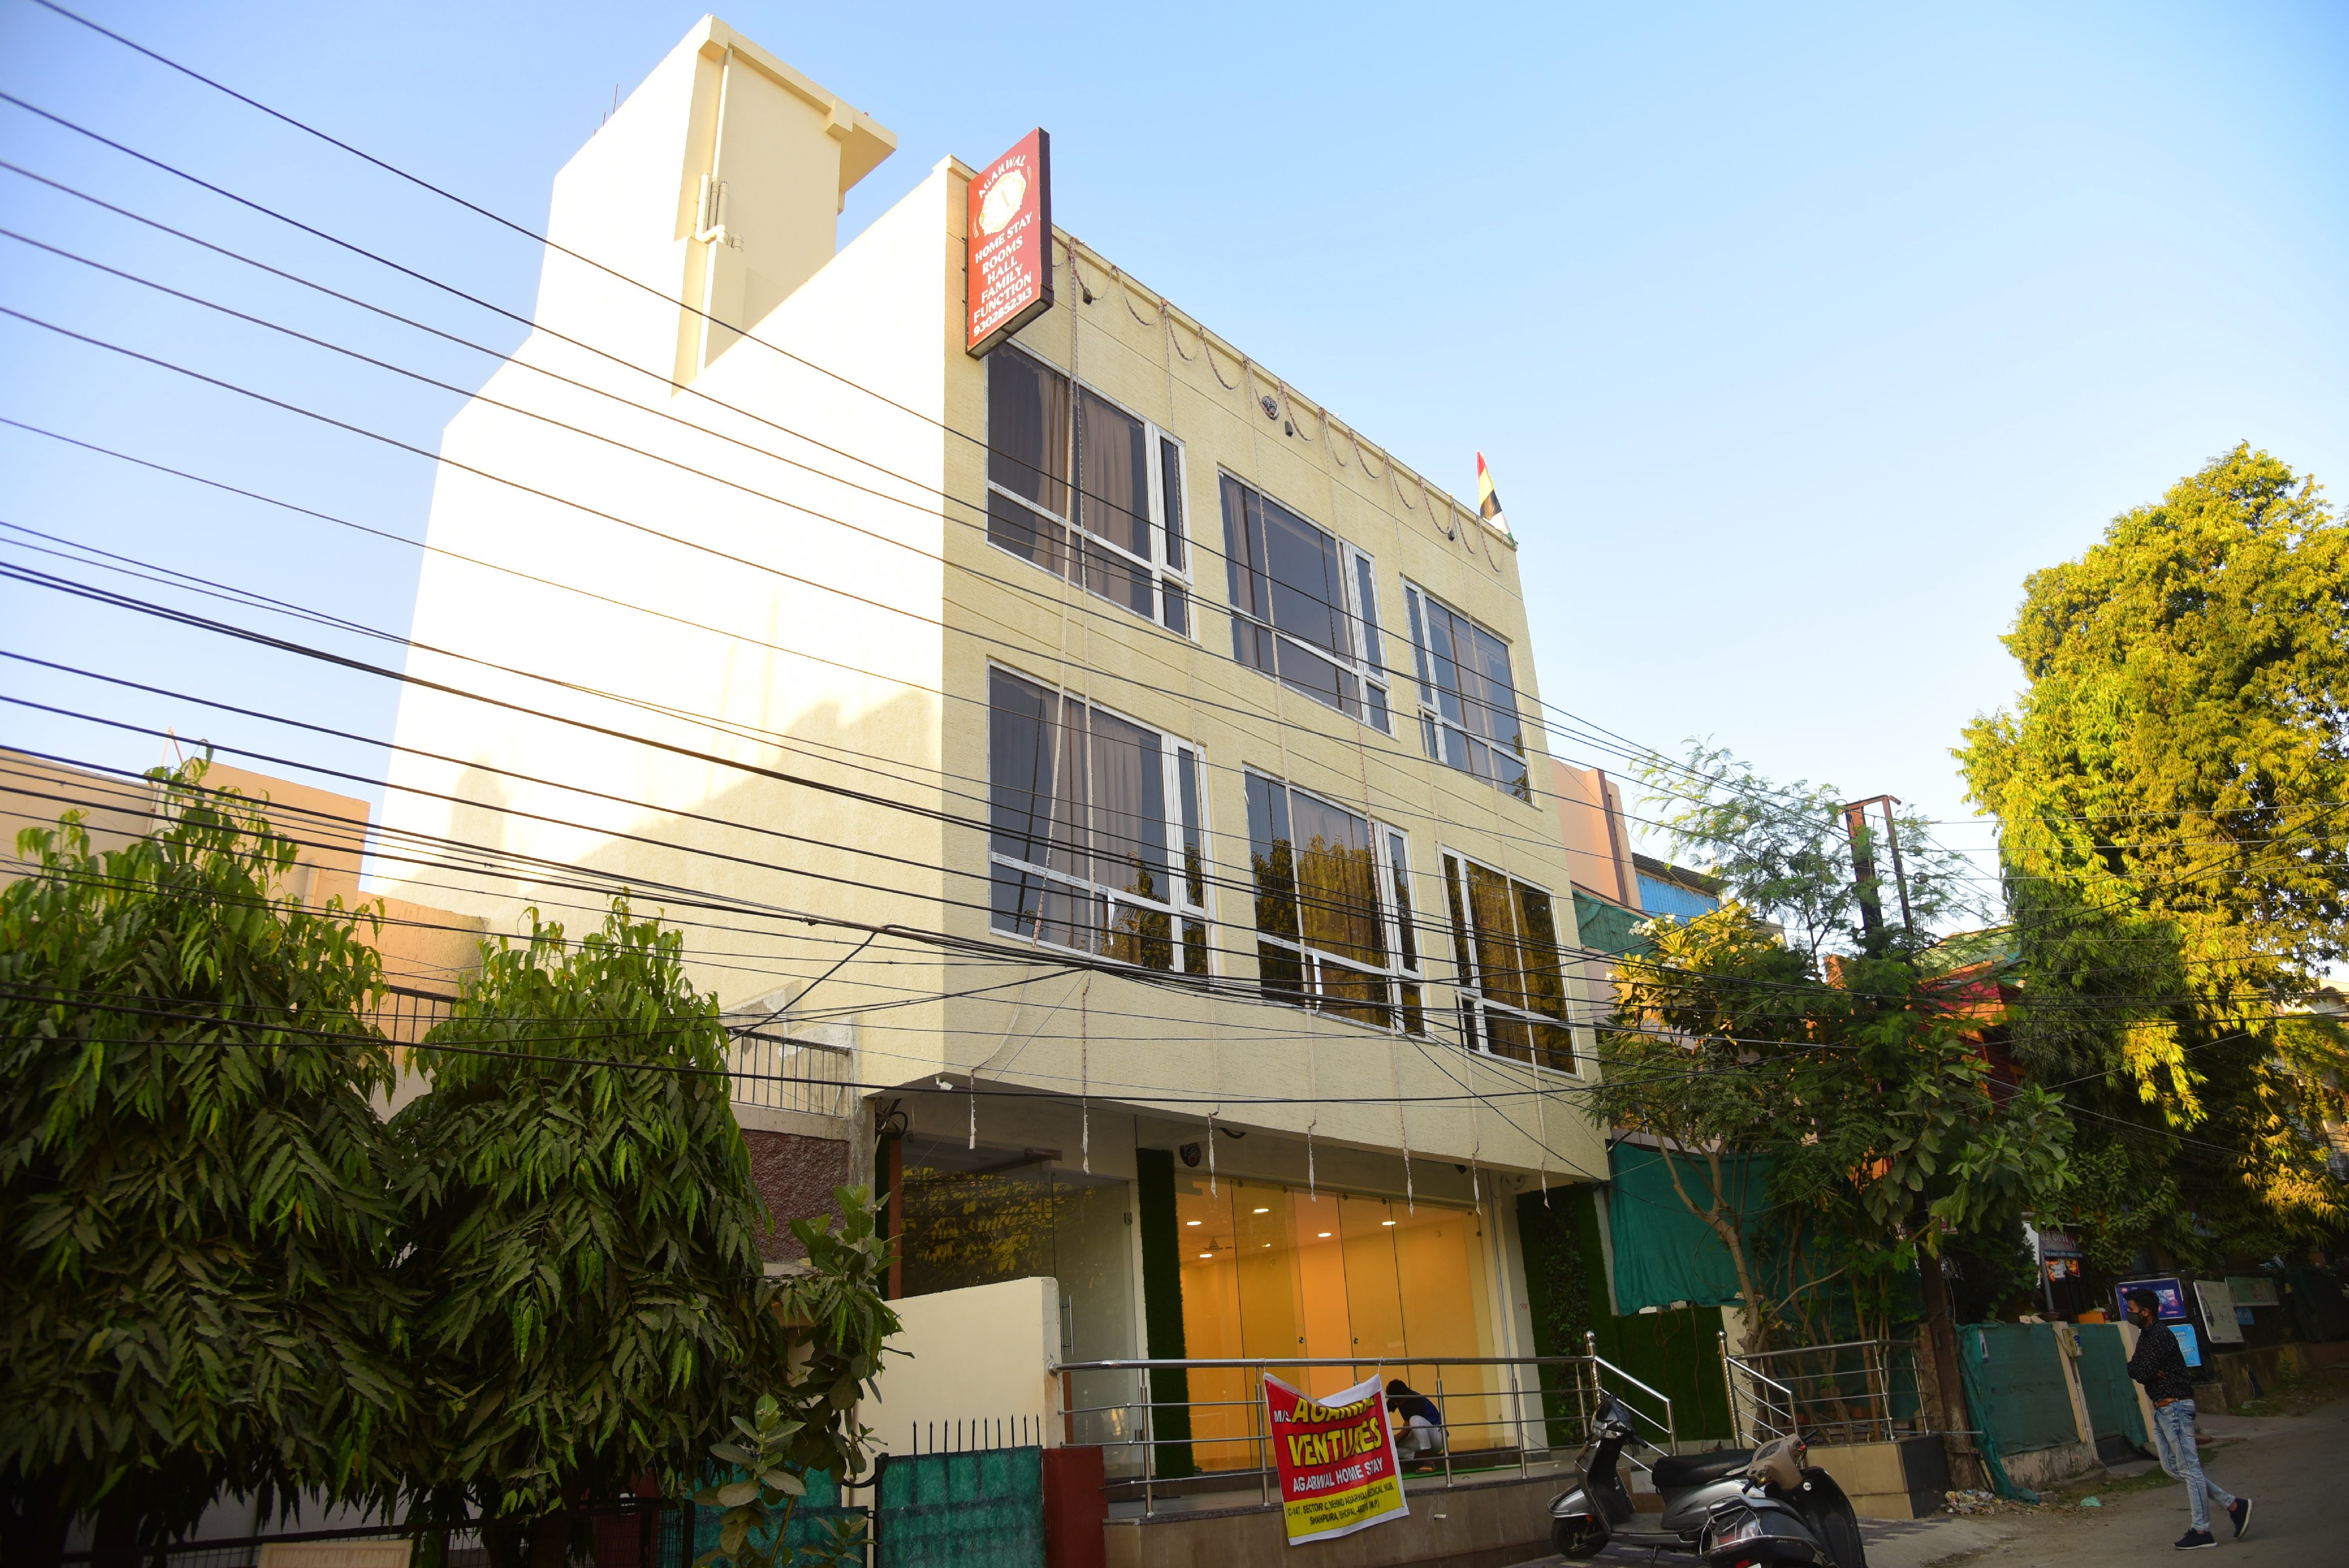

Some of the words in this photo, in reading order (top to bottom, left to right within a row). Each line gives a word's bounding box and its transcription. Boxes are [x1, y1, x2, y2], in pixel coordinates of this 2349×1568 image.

[978, 155, 1026, 199] AGARWAL
[975, 233, 1005, 264] HOME
[1007, 211, 1033, 238] STAY
[982, 235, 1023, 276] ROOMS
[981, 263, 1023, 304] FAMILY
[987, 256, 1017, 285] HALL
[973, 271, 1031, 324] FUNCTION
[973, 286, 1032, 337] 9302852313
[1286, 1416, 1382, 1468] VENTURES
[1293, 1472, 1335, 1493] AGARWAL
[1335, 1464, 1364, 1484] HOME
[1364, 1457, 1383, 1476] STAY
[1303, 1503, 1323, 1514] SECTOR
[1329, 1497, 1345, 1508] BEHIND
[1309, 1512, 1339, 1526] SHAHPURA,
[272, 1550, 347, 1567] VINDHYACHAL
[352, 1548, 403, 1566] ACADEMY
